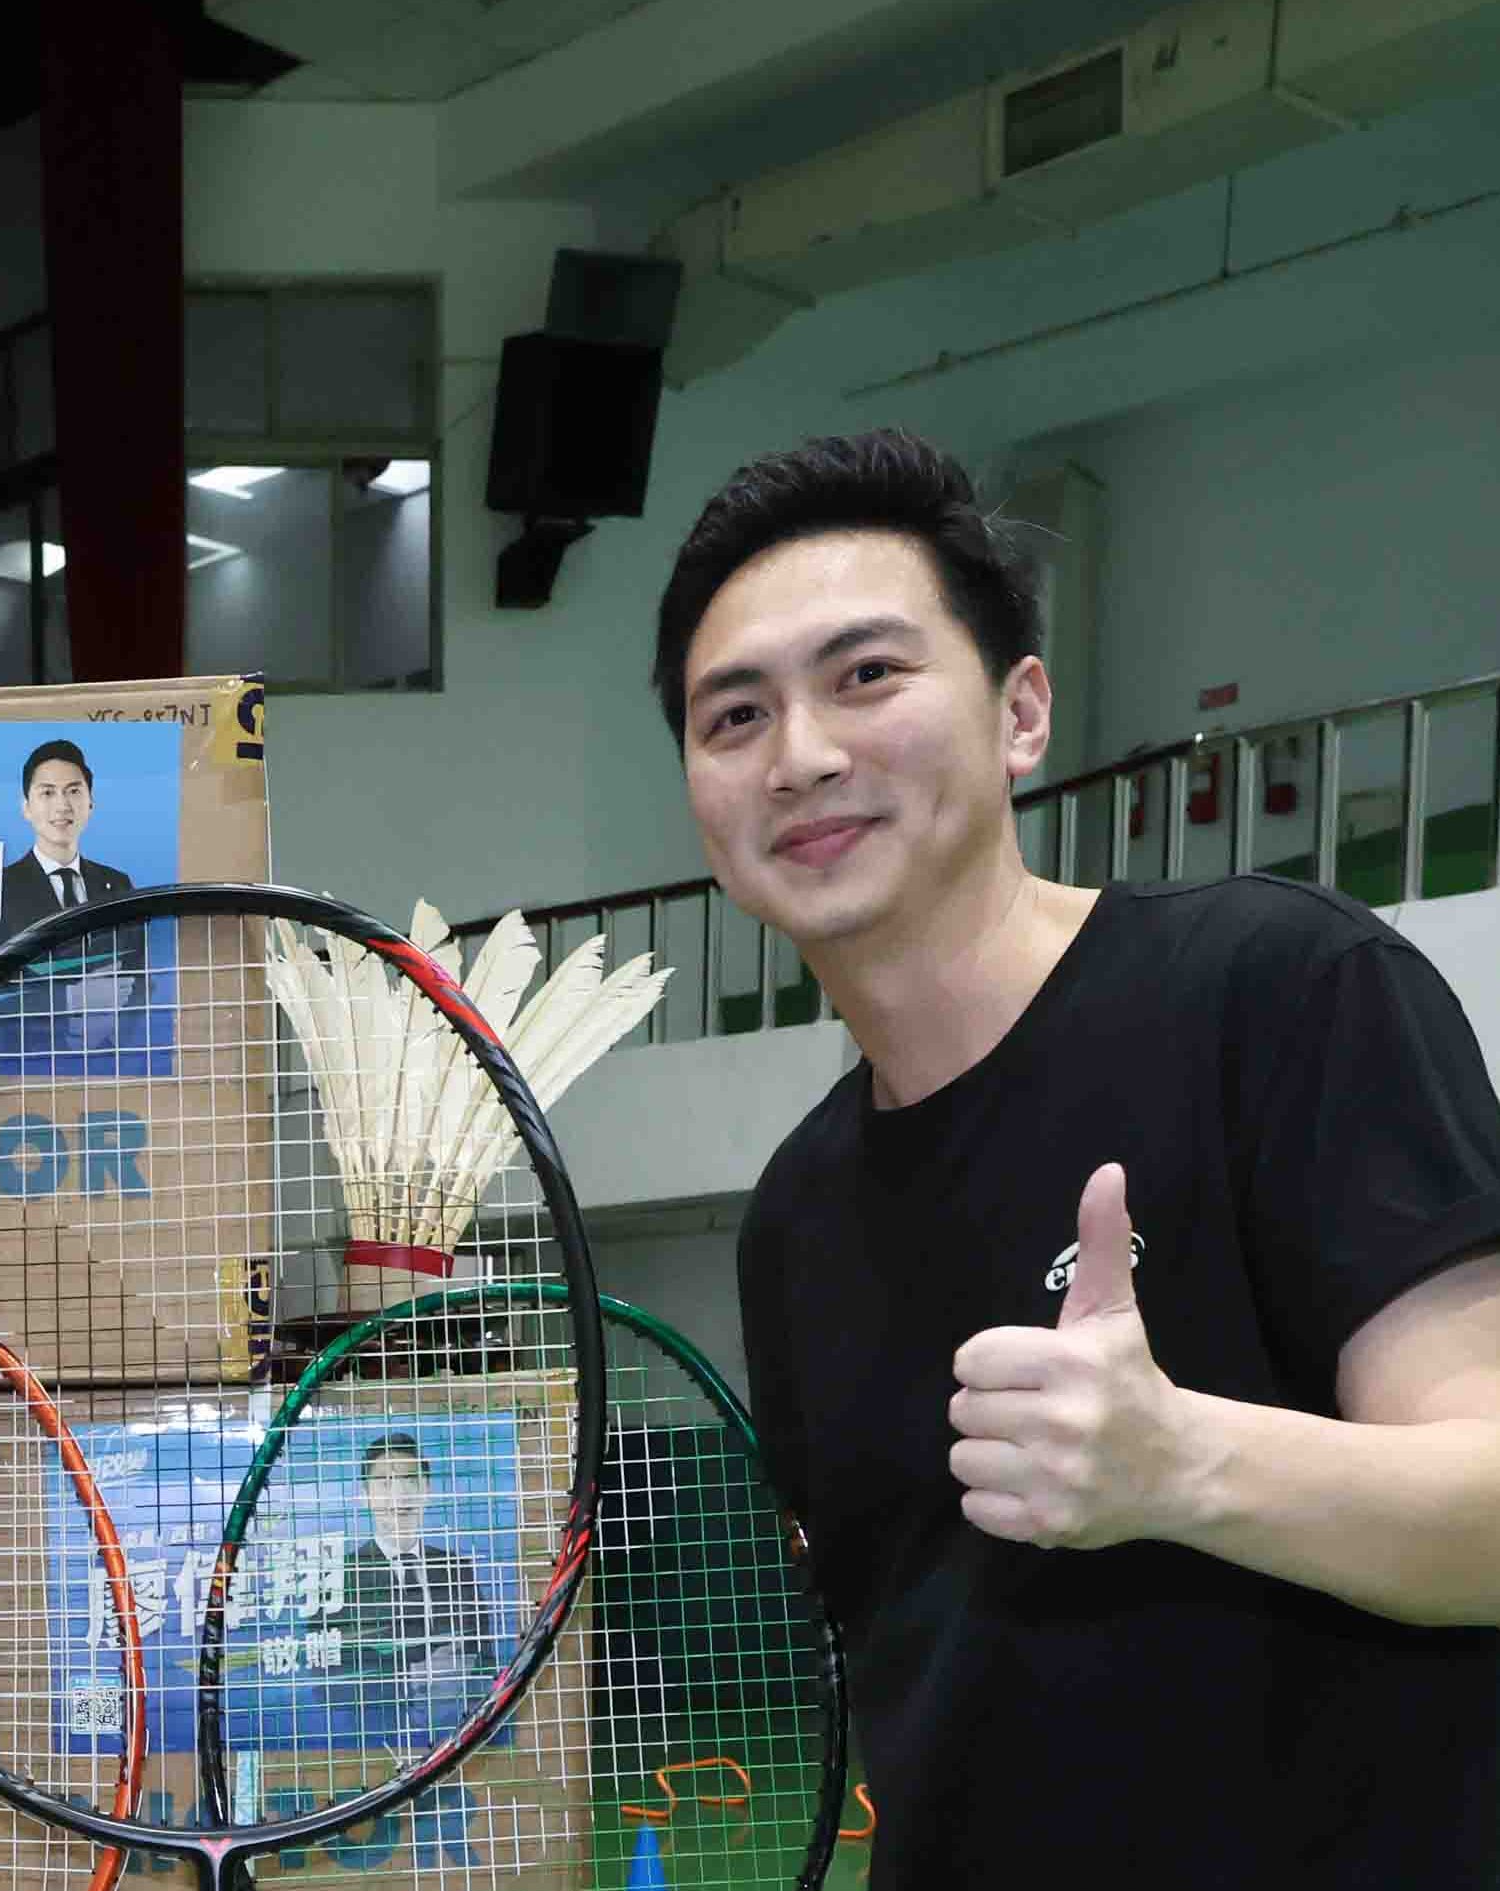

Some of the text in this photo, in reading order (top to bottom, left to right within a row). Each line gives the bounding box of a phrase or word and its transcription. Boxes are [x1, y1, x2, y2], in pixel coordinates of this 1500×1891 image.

[86, 1531, 346, 1648] 廖偉翔
[262, 1627, 342, 1675] 敬贈
